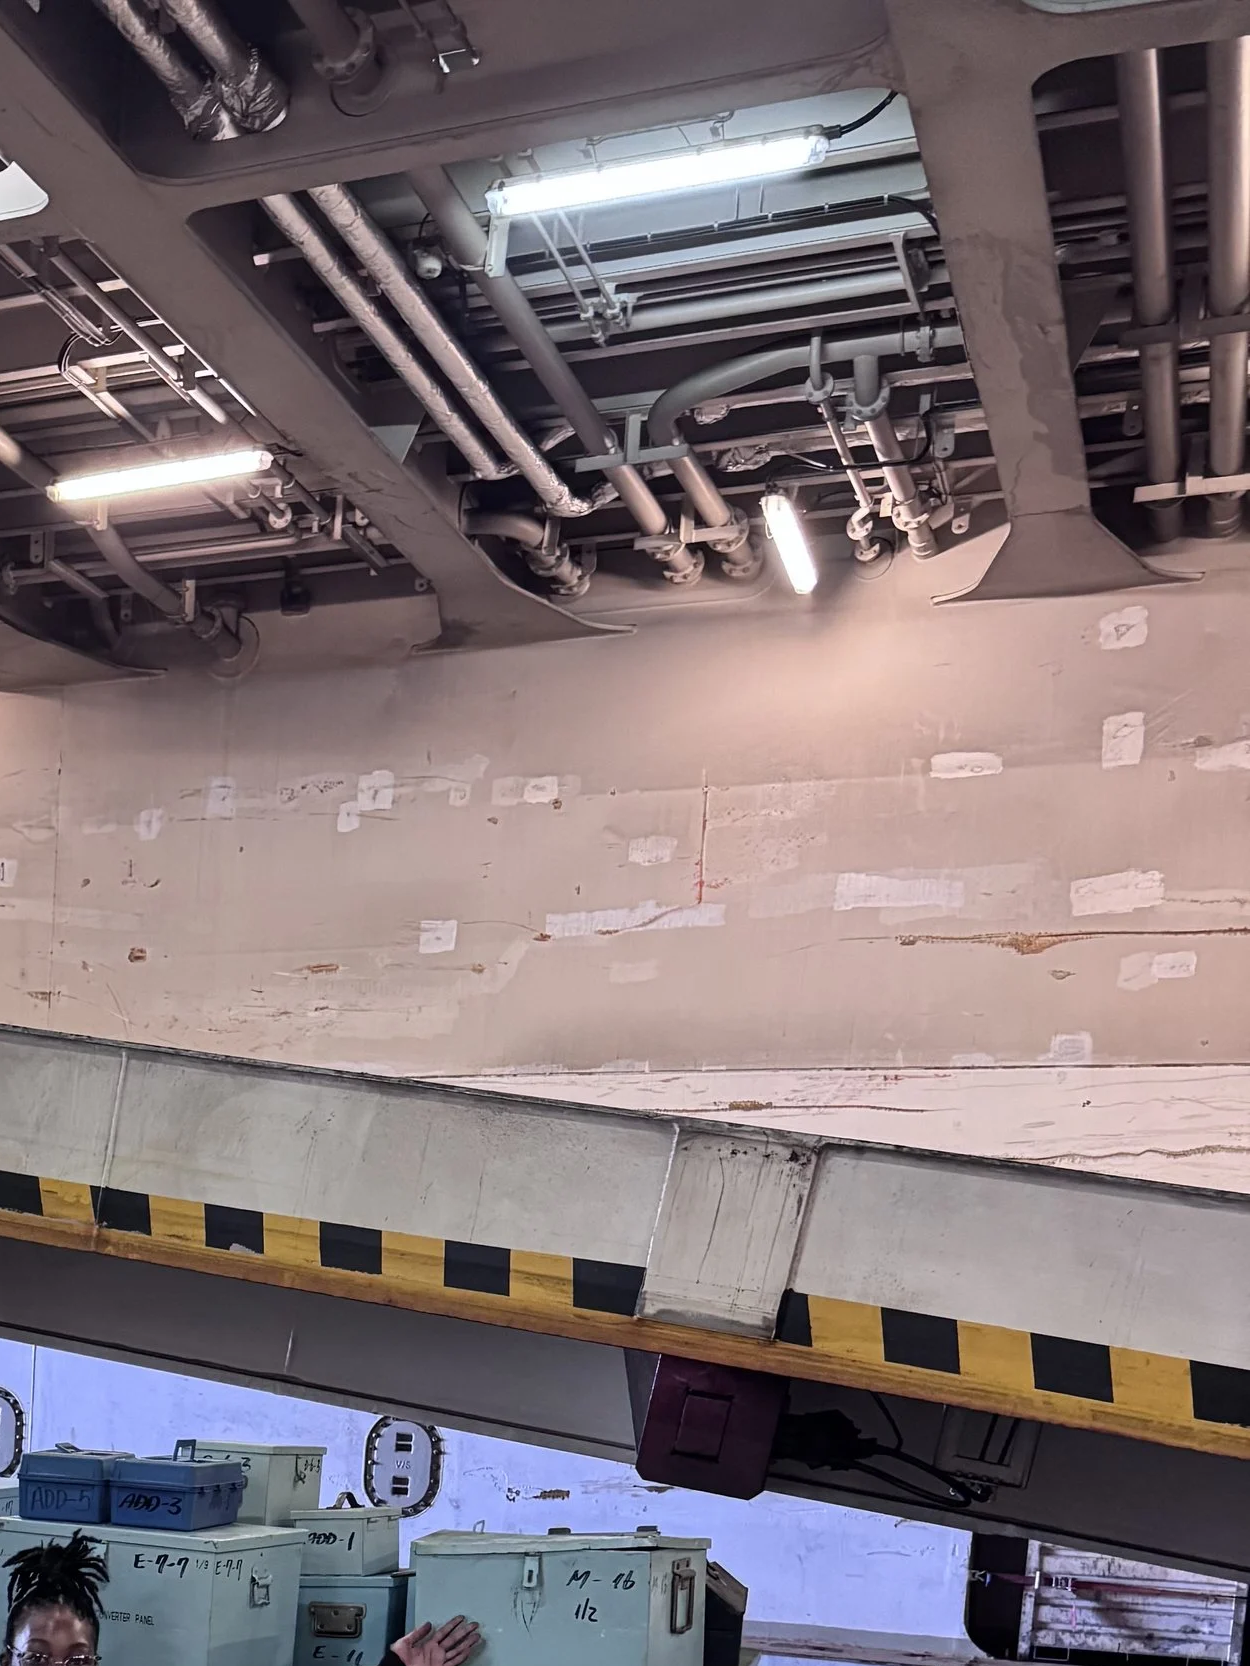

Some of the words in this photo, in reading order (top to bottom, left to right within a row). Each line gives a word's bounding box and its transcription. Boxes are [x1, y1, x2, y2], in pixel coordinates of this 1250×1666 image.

[30, 1485, 92, 1512] ADD-5
[118, 1492, 183, 1516] ADD-3
[133, 1553, 190, 1579] E-7-7
[215, 1558, 243, 1582] E-7-7
[135, 1612, 155, 1627] PANEL
[573, 1598, 599, 1625] 1/2
